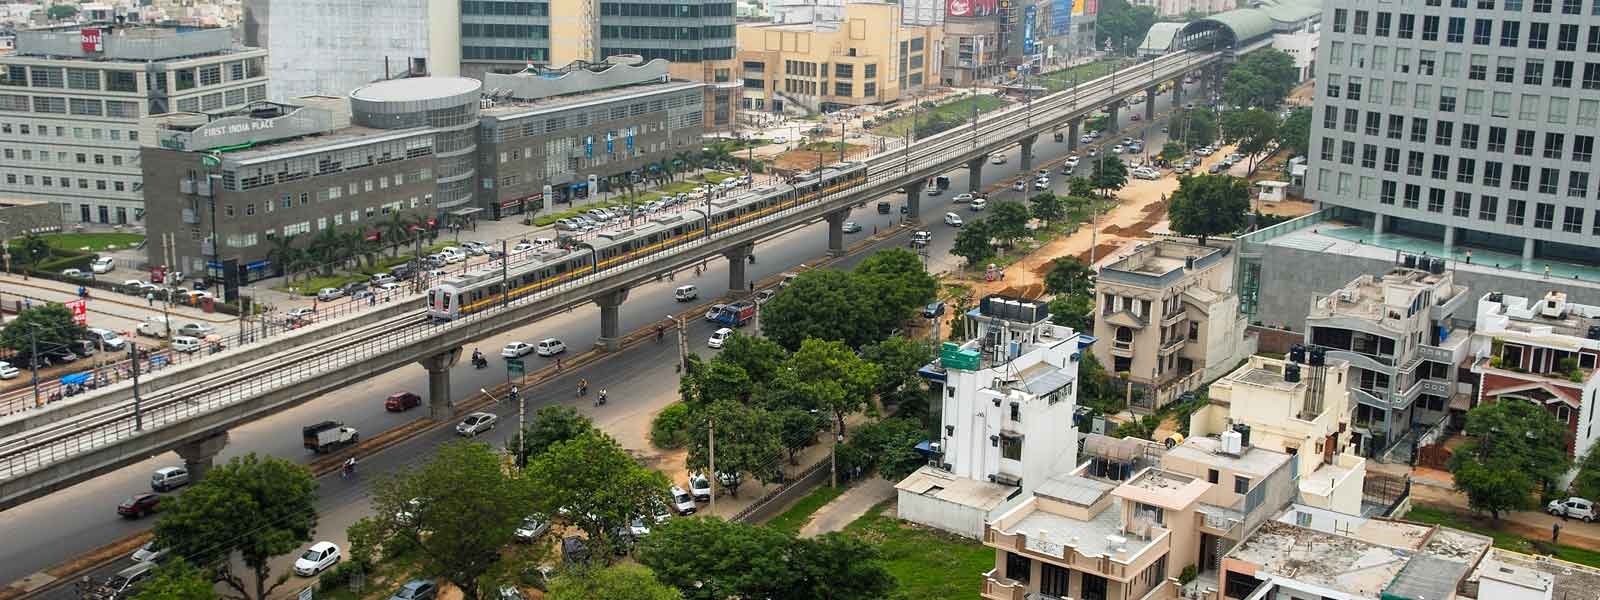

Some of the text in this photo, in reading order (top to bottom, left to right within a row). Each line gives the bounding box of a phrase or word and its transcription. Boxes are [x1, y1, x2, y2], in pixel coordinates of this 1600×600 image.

[204, 119, 275, 136] FIRST INDIA PLACE
